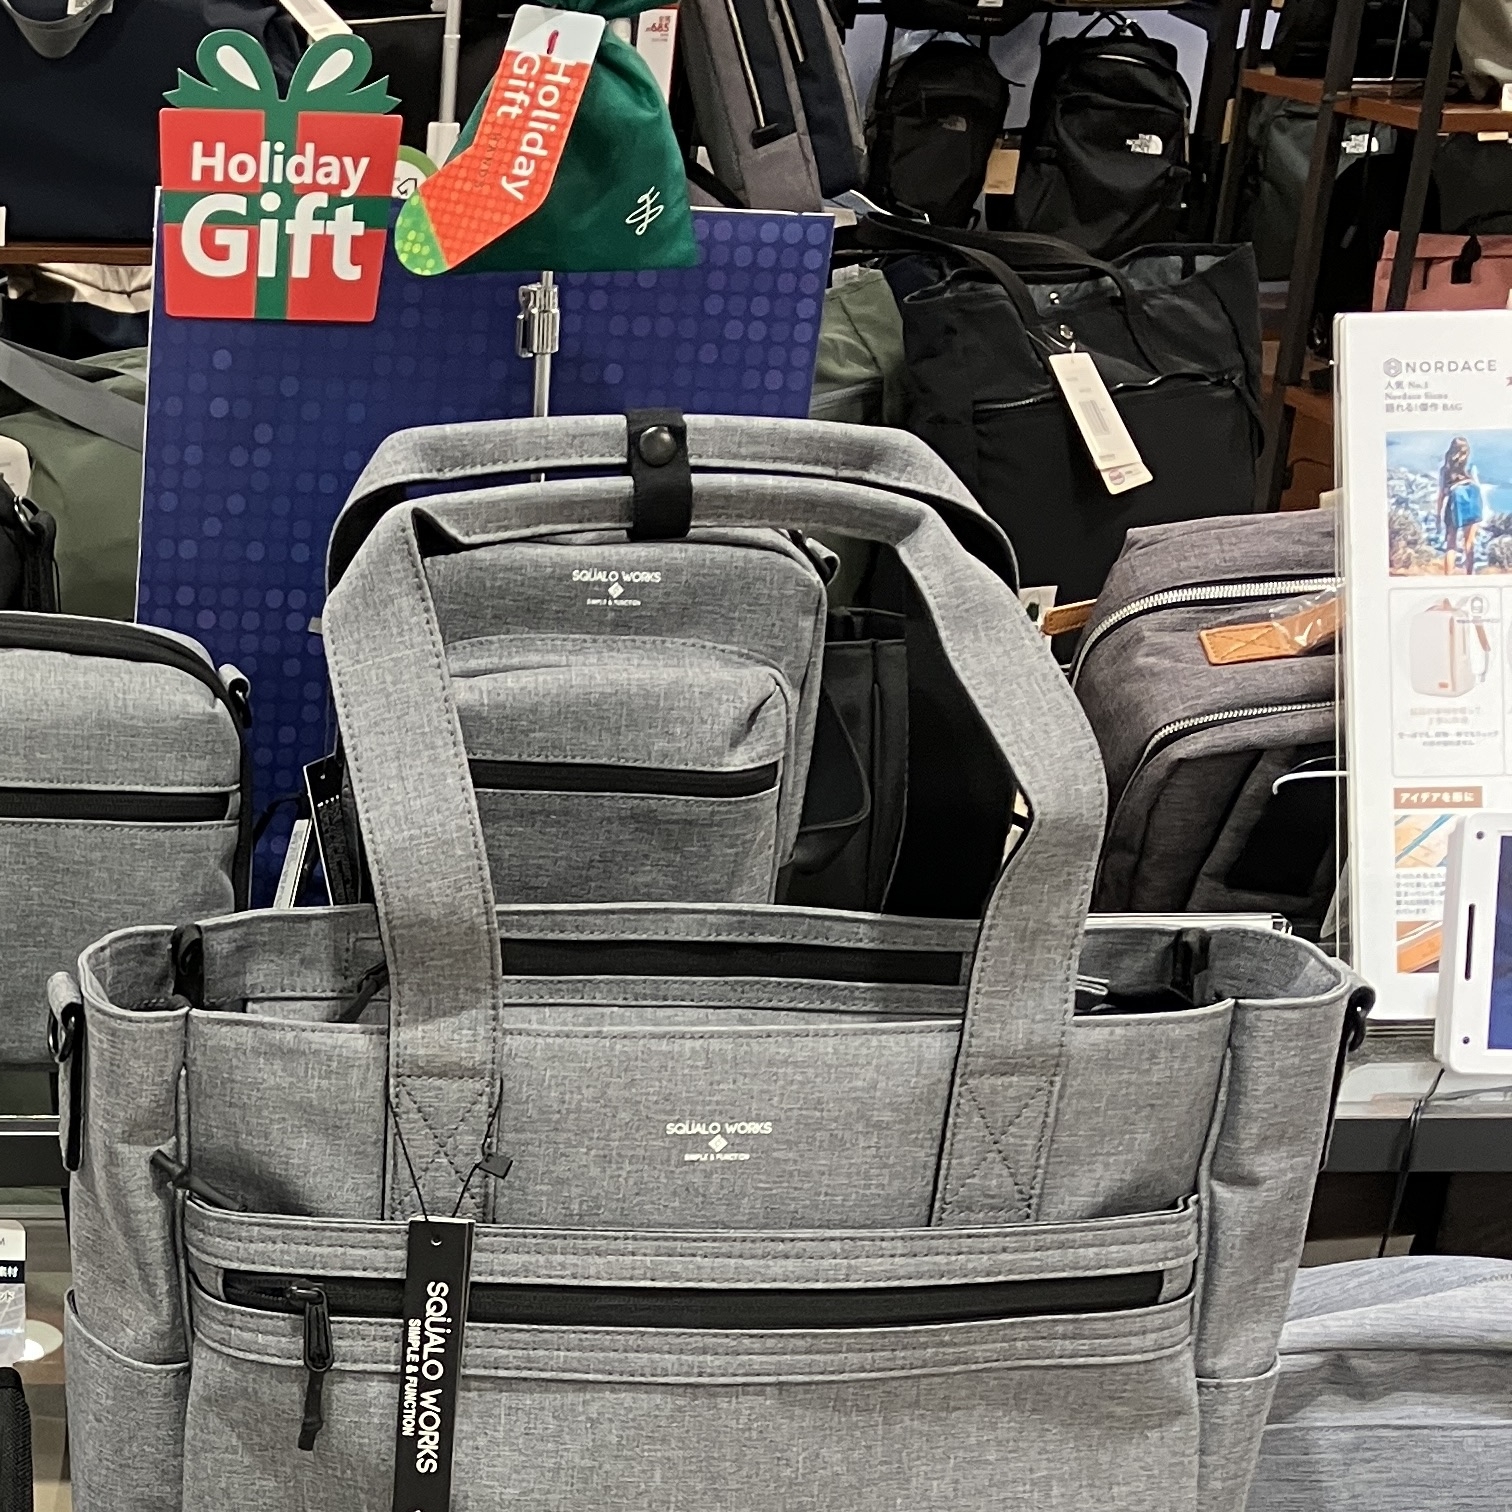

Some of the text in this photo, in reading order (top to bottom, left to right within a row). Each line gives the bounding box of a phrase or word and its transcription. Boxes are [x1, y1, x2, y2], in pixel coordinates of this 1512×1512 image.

[497, 51, 541, 120] Gift
[501, 59, 575, 201] Holiday
[191, 141, 371, 197] Holiday
[180, 191, 365, 280] Gift
[1406, 360, 1497, 373] NORDACE
[621, 571, 662, 583] WORKS
[724, 1122, 773, 1134] WORKS
[402, 1318, 422, 1437] SIMPLE & FUNCTION
[415, 1388, 443, 1474] WORKS
